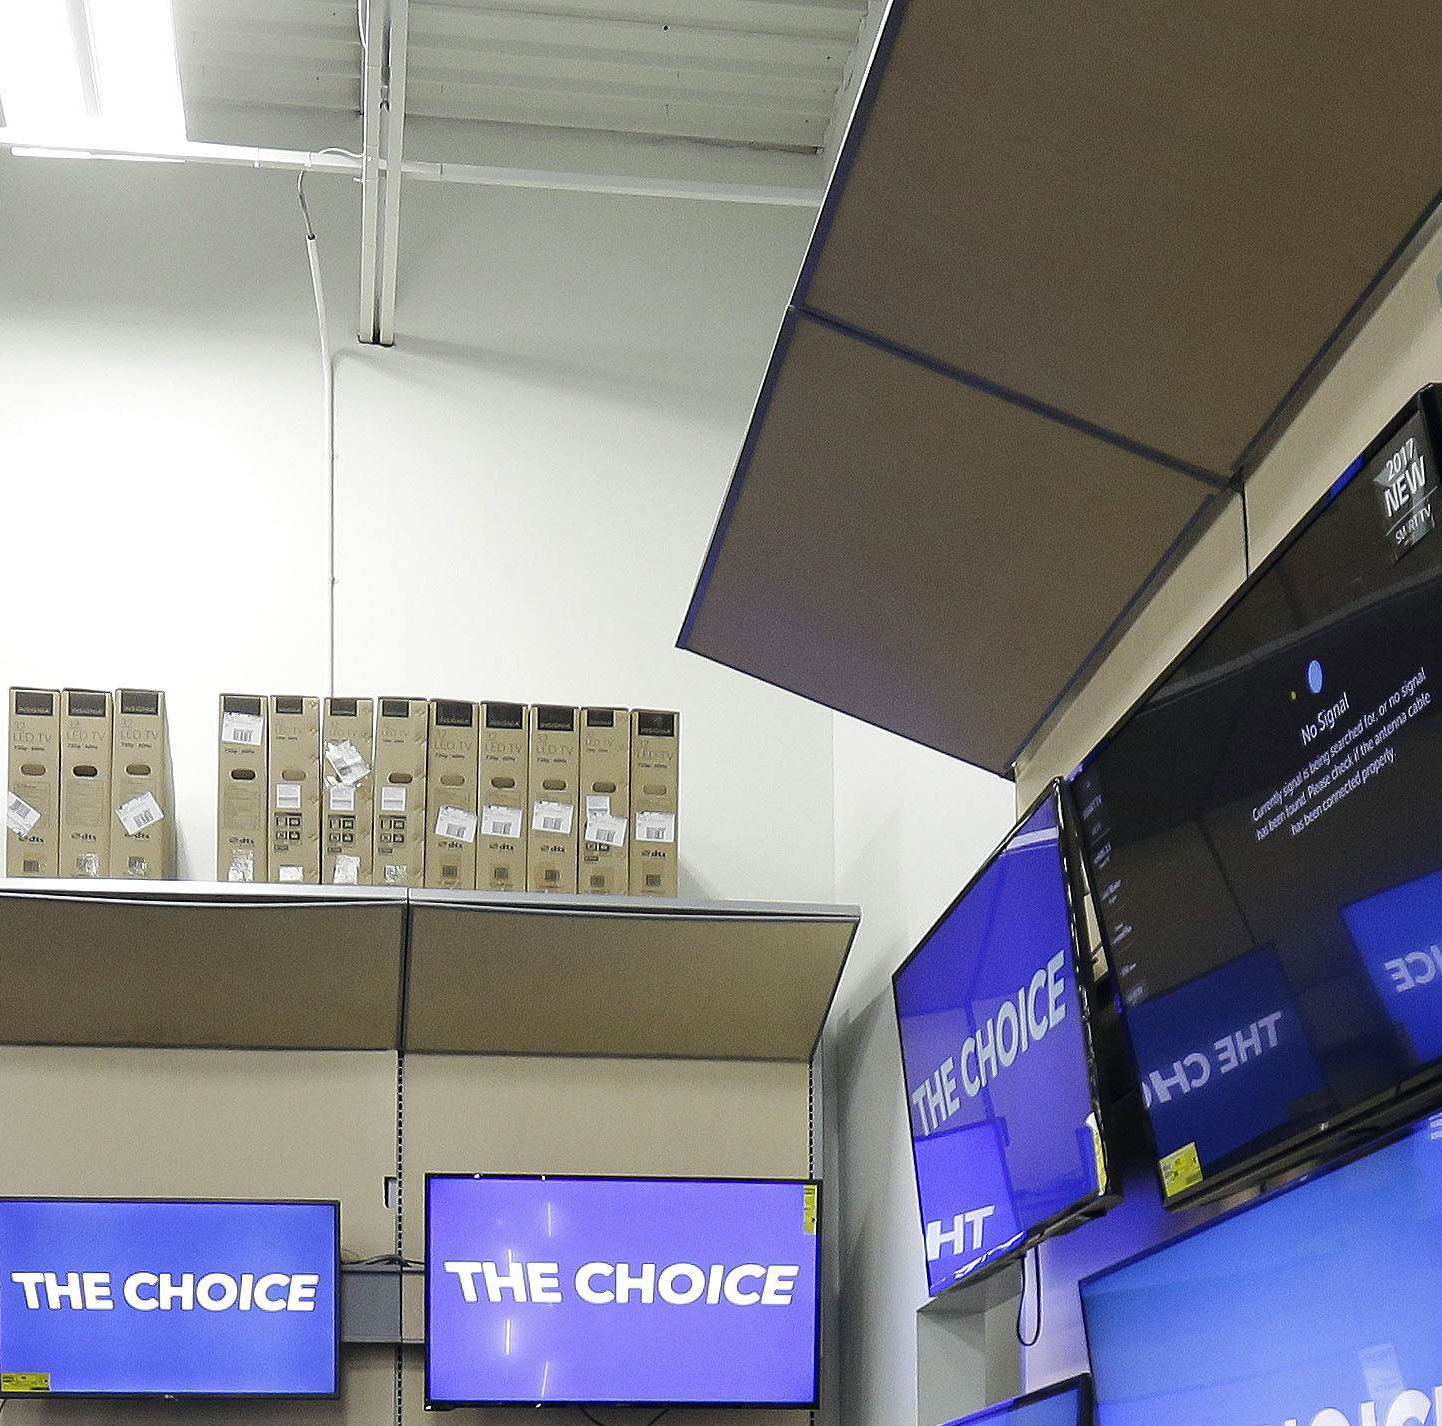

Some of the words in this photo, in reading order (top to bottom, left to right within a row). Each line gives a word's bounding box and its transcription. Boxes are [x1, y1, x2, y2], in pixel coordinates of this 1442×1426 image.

[1386, 437, 1415, 481] 2017
[1384, 455, 1426, 517] NEW
[13, 732, 34, 743] LED
[37, 733, 52, 743] TV
[91, 731, 106, 742] TV
[119, 729, 141, 740] LED
[144, 730, 159, 741] TV
[1299, 724, 1318, 746] No
[1317, 691, 1351, 733] Signal
[1252, 789, 1284, 822] Currently
[1302, 764, 1310, 780] is
[1309, 750, 1331, 776] being
[1330, 719, 1365, 758] searched
[1378, 701, 1389, 717] or
[1388, 691, 1401, 709] no
[1399, 667, 1427, 700] signal
[1256, 822, 1269, 841] has
[1268, 809, 1287, 832] been
[1307, 772, 1332, 799] Please
[1331, 752, 1354, 781] check
[1360, 736, 1376, 757] the
[1374, 711, 1408, 746] antenna
[1407, 691, 1432, 719] cable
[1290, 817, 1305, 836] has
[1303, 804, 1323, 827] been
[1322, 770, 1362, 812] connected
[912, 1057, 960, 1137] THE
[960, 951, 1066, 1103] CHOICE
[11, 1272, 115, 1311] THE
[123, 1273, 319, 1313] CHOICE
[445, 1261, 562, 1304] THE
[574, 1262, 800, 1305] CHOICE
